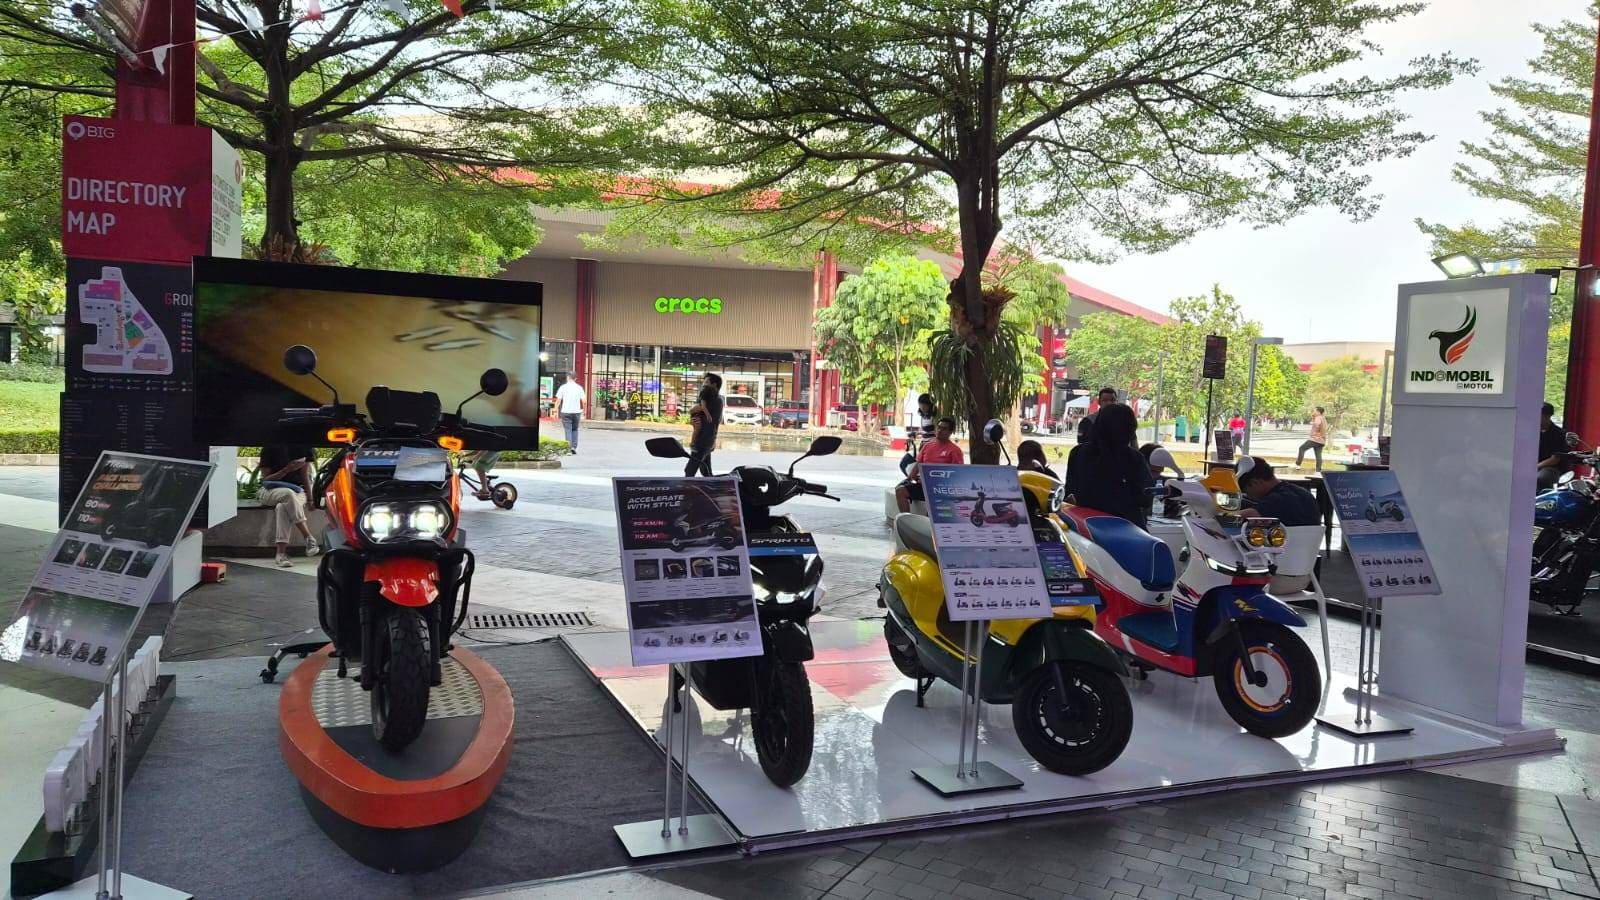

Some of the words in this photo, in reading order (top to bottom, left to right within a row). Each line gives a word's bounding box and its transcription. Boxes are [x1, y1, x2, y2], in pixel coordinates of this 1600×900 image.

[87, 125, 115, 138] BIG
[68, 177, 186, 208] DIRECTORY
[67, 210, 116, 235] MAP
[164, 292, 193, 306] GRO
[655, 297, 722, 314] crocs
[1410, 370, 1495, 382] INDOMOBIL
[627, 494, 685, 504] ACCELERATE
[627, 502, 650, 510] WITH
[651, 500, 681, 508] STYLE
